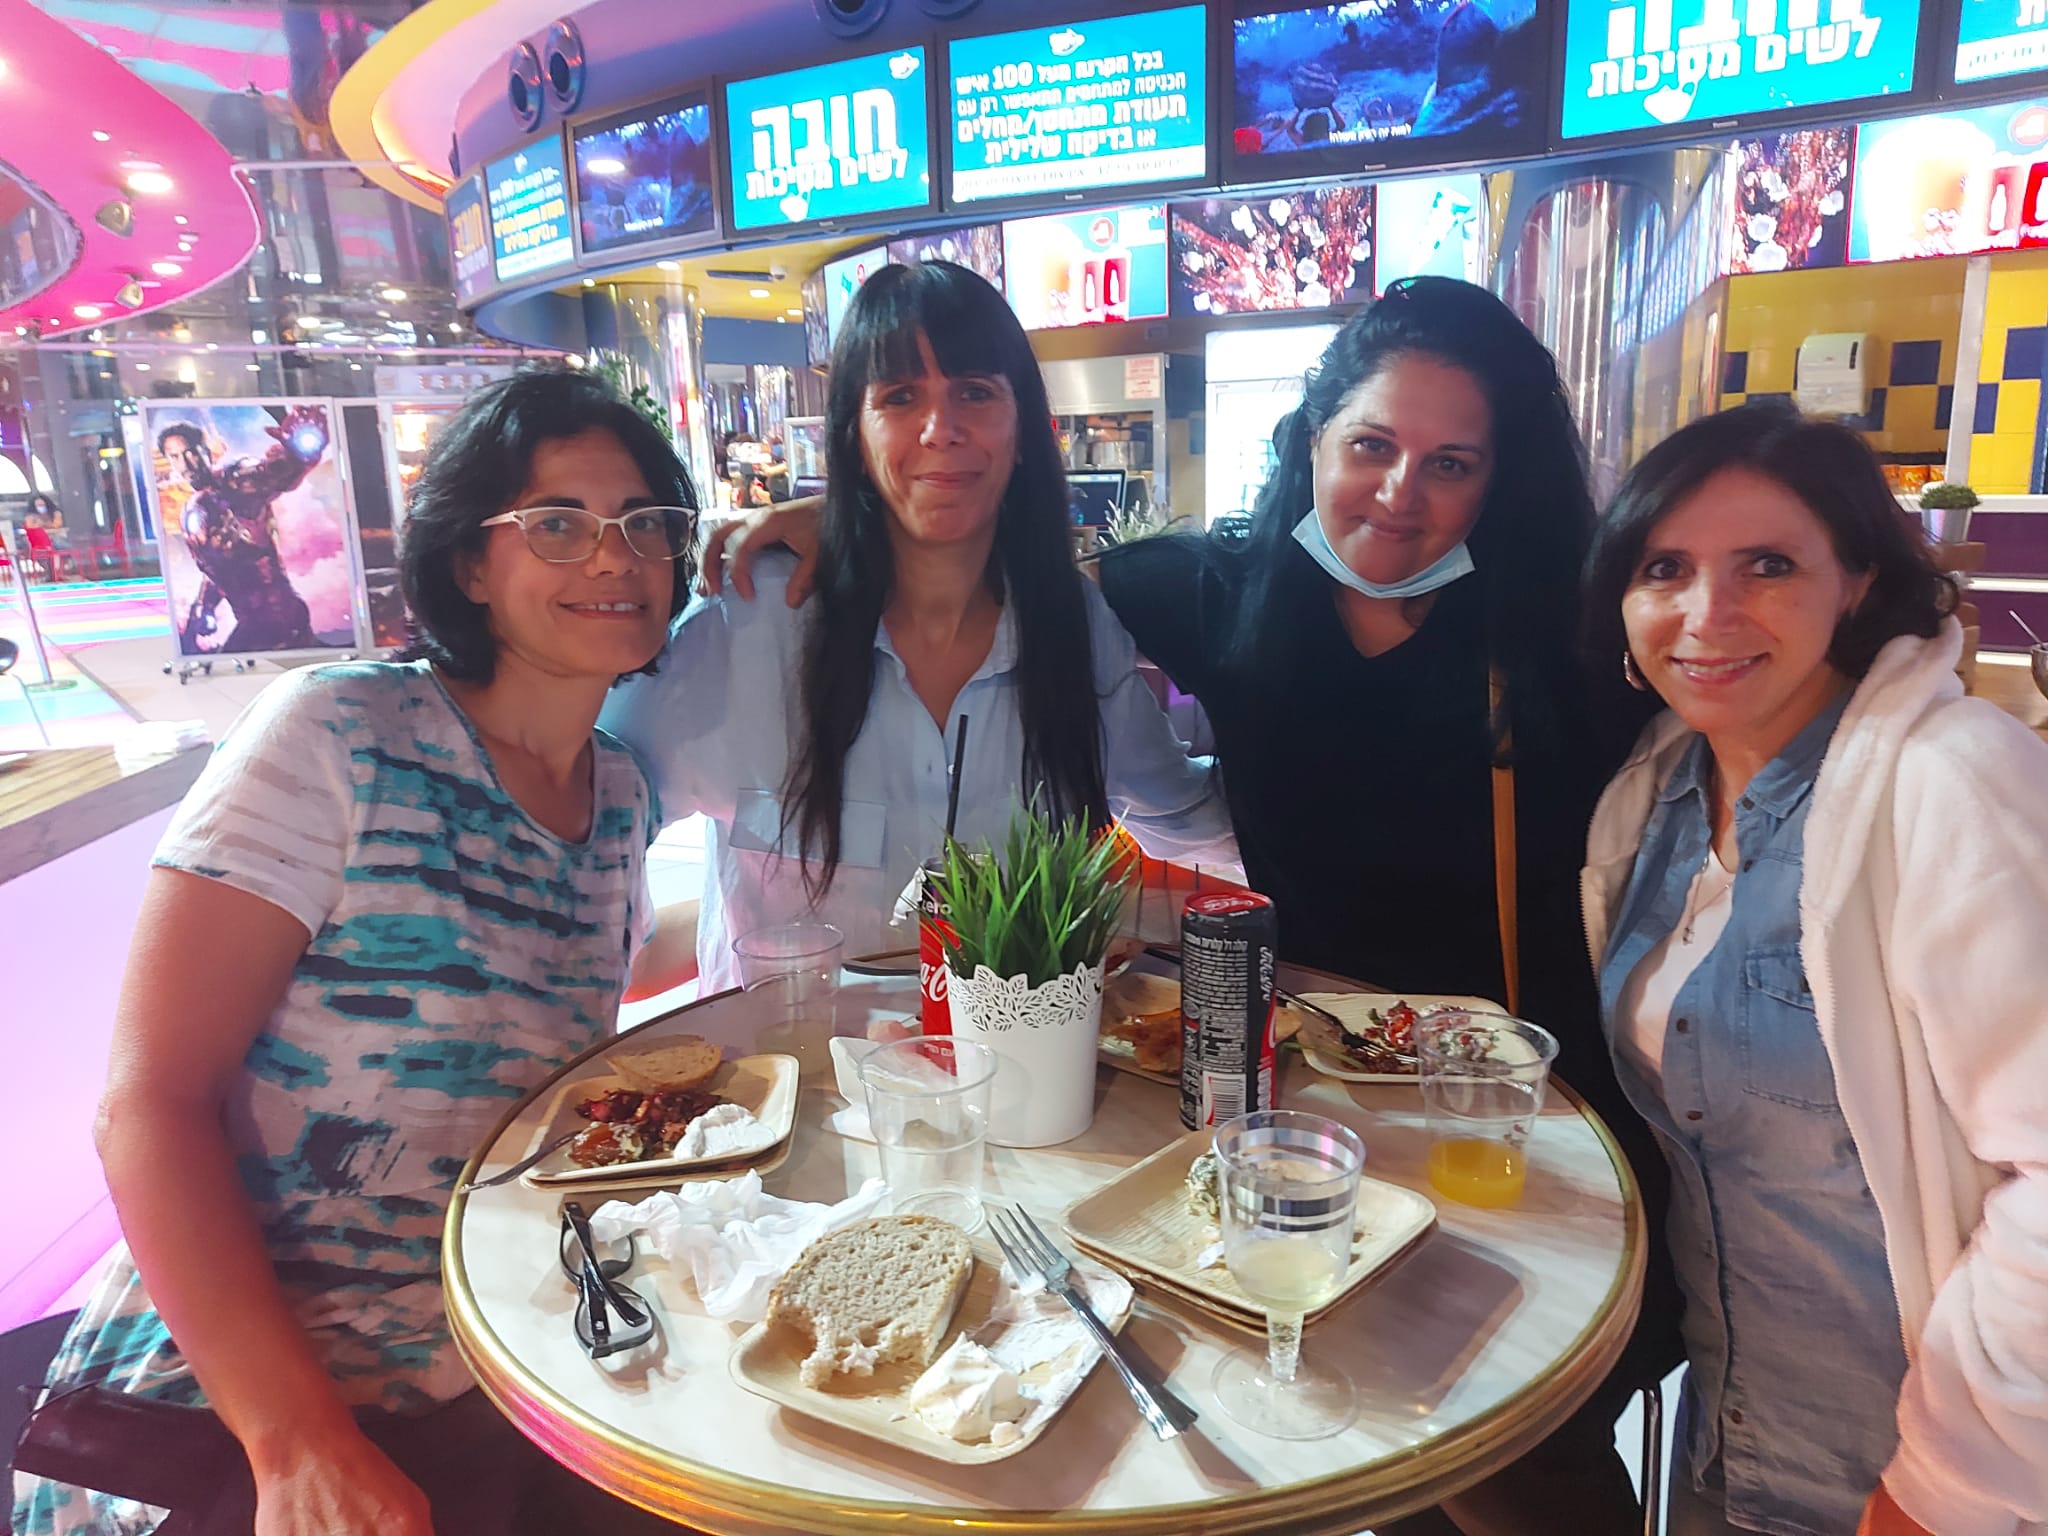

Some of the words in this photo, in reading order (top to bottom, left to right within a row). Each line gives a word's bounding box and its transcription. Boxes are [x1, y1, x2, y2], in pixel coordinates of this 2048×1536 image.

[1754, 17, 1882, 73] לשים
[1131, 50, 1164, 72] בכל
[1587, 41, 1741, 98] מסיכות
[956, 73, 989, 95] איש
[992, 62, 1034, 90] 100
[1134, 71, 1186, 95] הכניסה
[957, 98, 977, 117] עם
[980, 96, 999, 117] רק
[1112, 93, 1187, 125] תעודת
[751, 88, 896, 171] חובה
[1066, 126, 1134, 157] בדיקה
[1136, 128, 1157, 148] או
[984, 134, 1062, 164] שלילית
[839, 147, 908, 187] לשים
